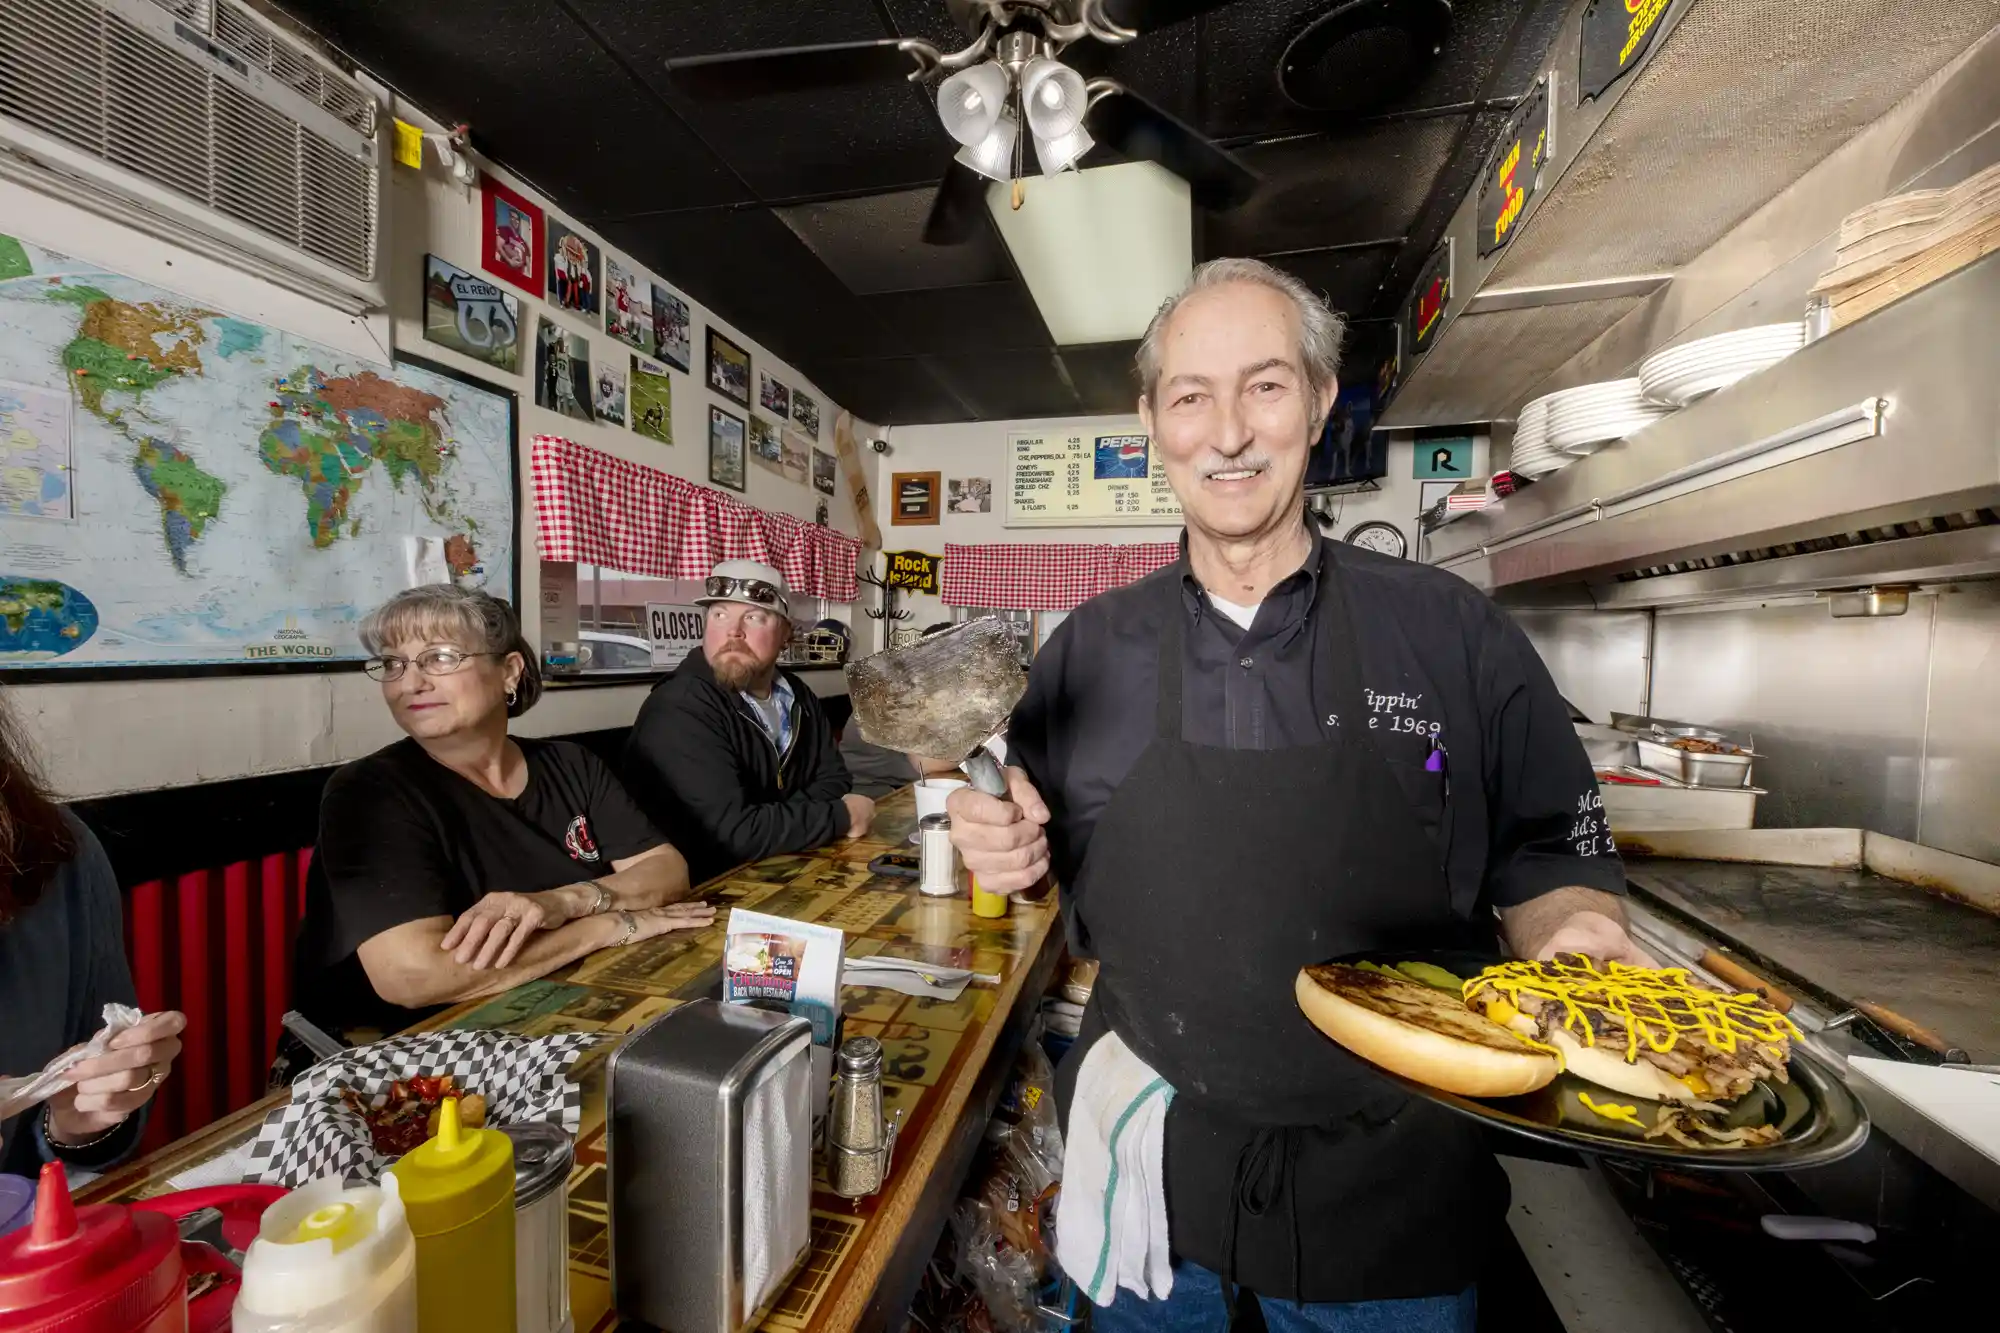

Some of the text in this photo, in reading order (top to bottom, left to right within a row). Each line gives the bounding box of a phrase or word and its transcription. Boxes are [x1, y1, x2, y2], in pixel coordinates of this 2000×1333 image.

[1499, 139, 1521, 188] MAN
[1495, 187, 1524, 244] FOOD
[456, 283, 497, 296] EL RENO
[1099, 436, 1148, 448] PEPSI
[894, 555, 930, 573] Rock
[889, 570, 932, 588] Island
[651, 610, 703, 640] CLOSED
[247, 645, 333, 657] THE WORLD
[1389, 715, 1441, 735] 1969
[1575, 836, 1600, 857] El
[733, 971, 793, 989] Oklahoma
[773, 968, 792, 977] OPEN
[733, 986, 793, 1000] BACK ROAD RESTAURANT
